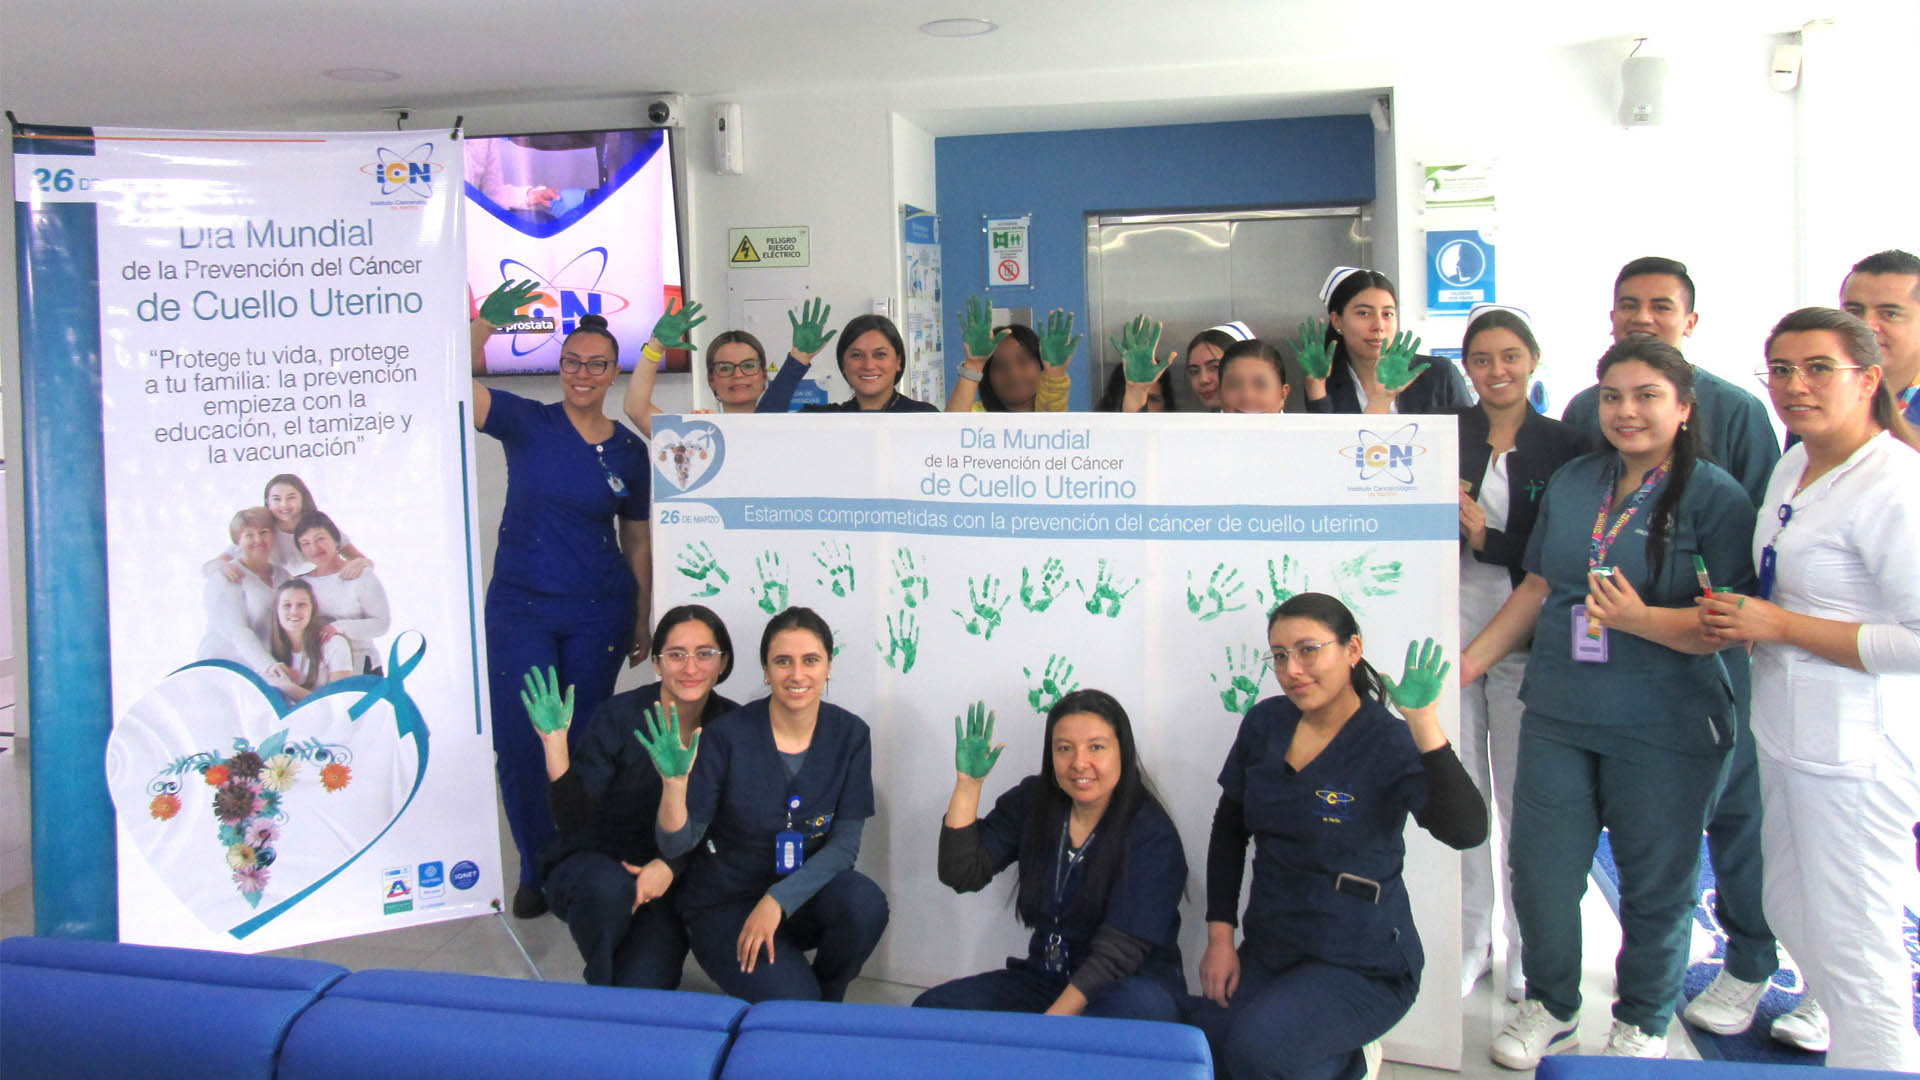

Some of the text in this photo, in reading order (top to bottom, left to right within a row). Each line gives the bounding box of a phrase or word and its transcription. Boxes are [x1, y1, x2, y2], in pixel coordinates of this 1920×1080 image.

[246, 218, 374, 249] Mundial
[766, 236, 797, 244] PELIGRO
[122, 255, 423, 280] de la Prevención del Cáncer
[136, 286, 423, 322] de Cuello Uterino
[246, 348, 266, 366] tu
[272, 344, 322, 366] vida,
[330, 343, 410, 367] protege
[145, 363, 417, 394] a tu familia: la prevención
[203, 389, 367, 419] empieza con la
[155, 411, 413, 443] educación, el tamizaje y
[960, 427, 1091, 450] Día Mundial
[208, 444, 227, 464] la
[924, 454, 1124, 470] de la Prevención del Cáncer
[920, 472, 1137, 499] de Cuello Uterino
[659, 509, 721, 525] 26 DE MARZO
[744, 505, 1380, 534] Estamos comprometidas con la prevención del cáncer de cuello uterino
